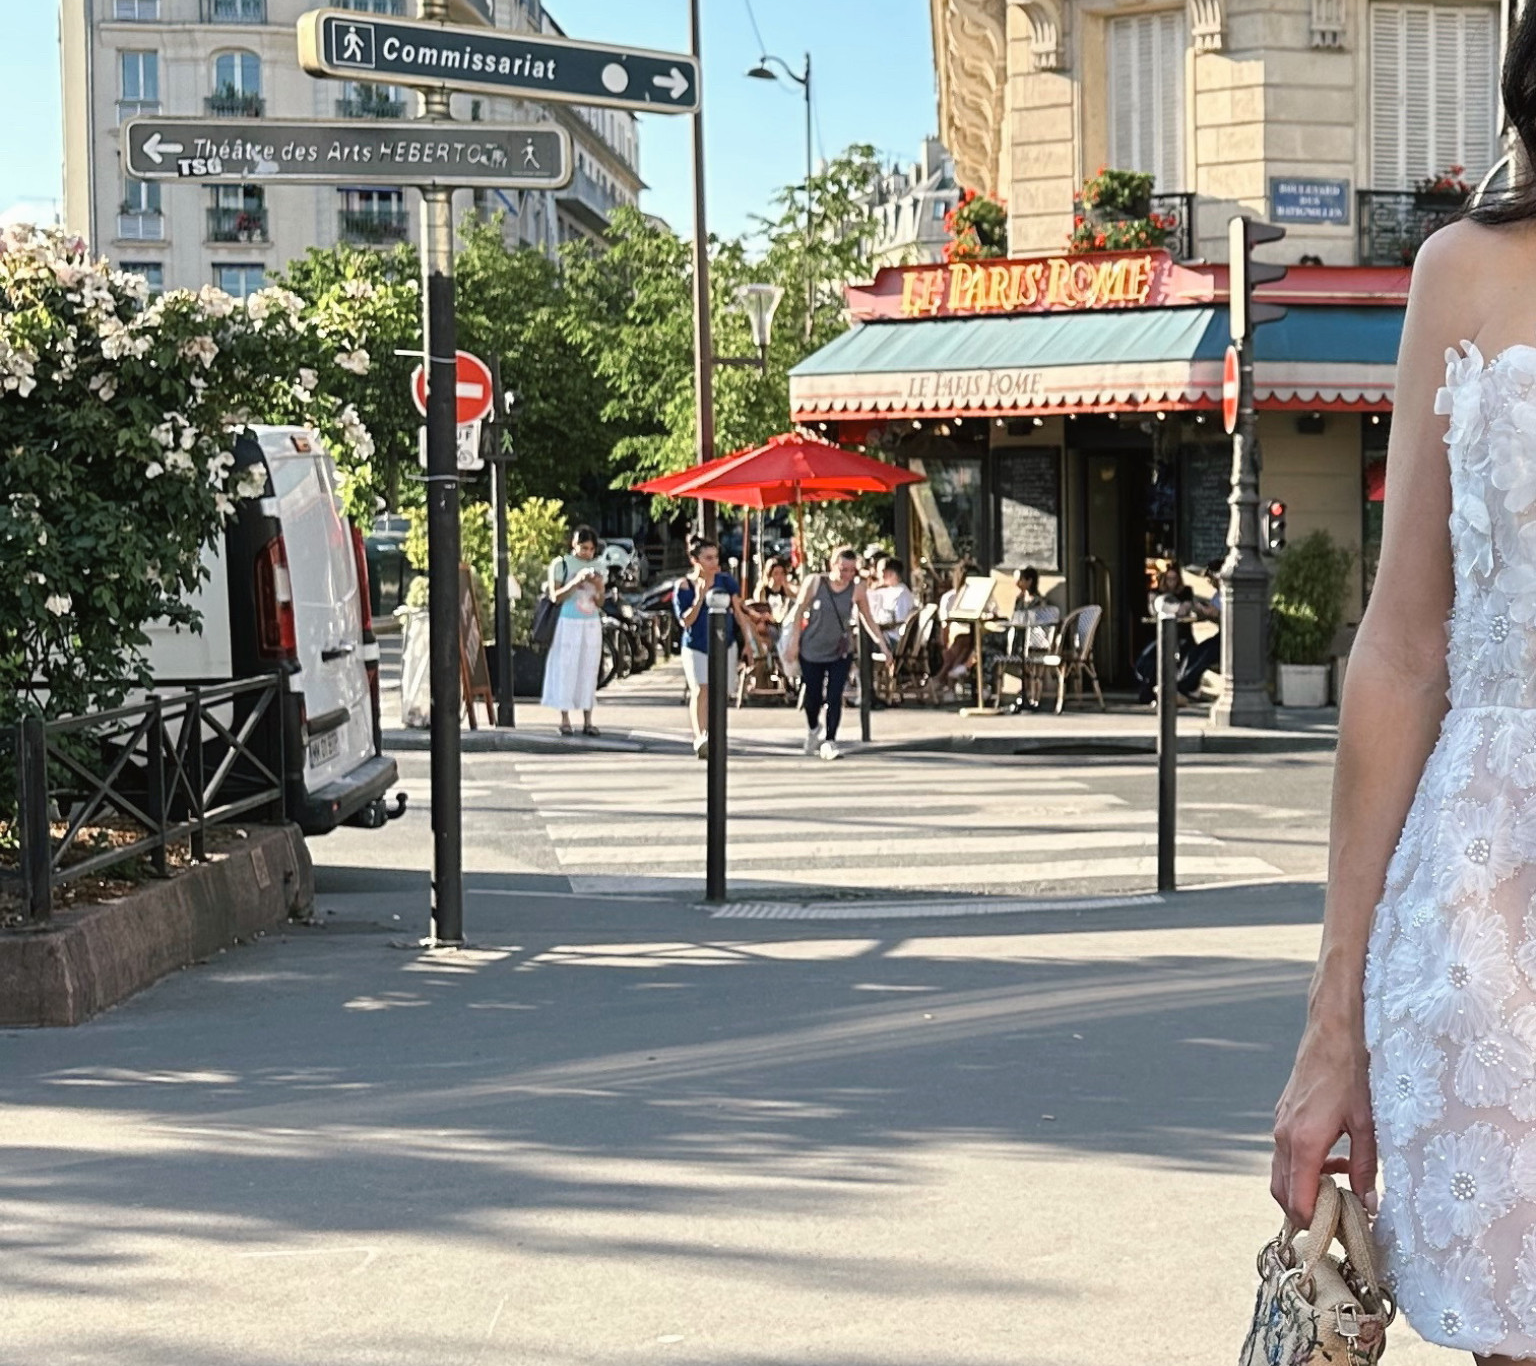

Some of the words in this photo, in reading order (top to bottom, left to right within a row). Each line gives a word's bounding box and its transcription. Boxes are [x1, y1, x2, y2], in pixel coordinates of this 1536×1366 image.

[382, 37, 557, 81] Commissariat
[194, 138, 275, 162] Théâtre
[281, 141, 318, 162] des
[327, 141, 373, 163] Arts
[1278, 183, 1341, 196] BOULEVARD
[1299, 196, 1321, 206] DES
[1275, 205, 1343, 218] BATIGNOLLES
[901, 269, 943, 316] LE
[947, 262, 1043, 312] PARIS
[1047, 255, 1152, 308] ROME
[907, 377, 930, 399] LE
[933, 372, 985, 398] PARIS
[985, 370, 1043, 397] ROME
